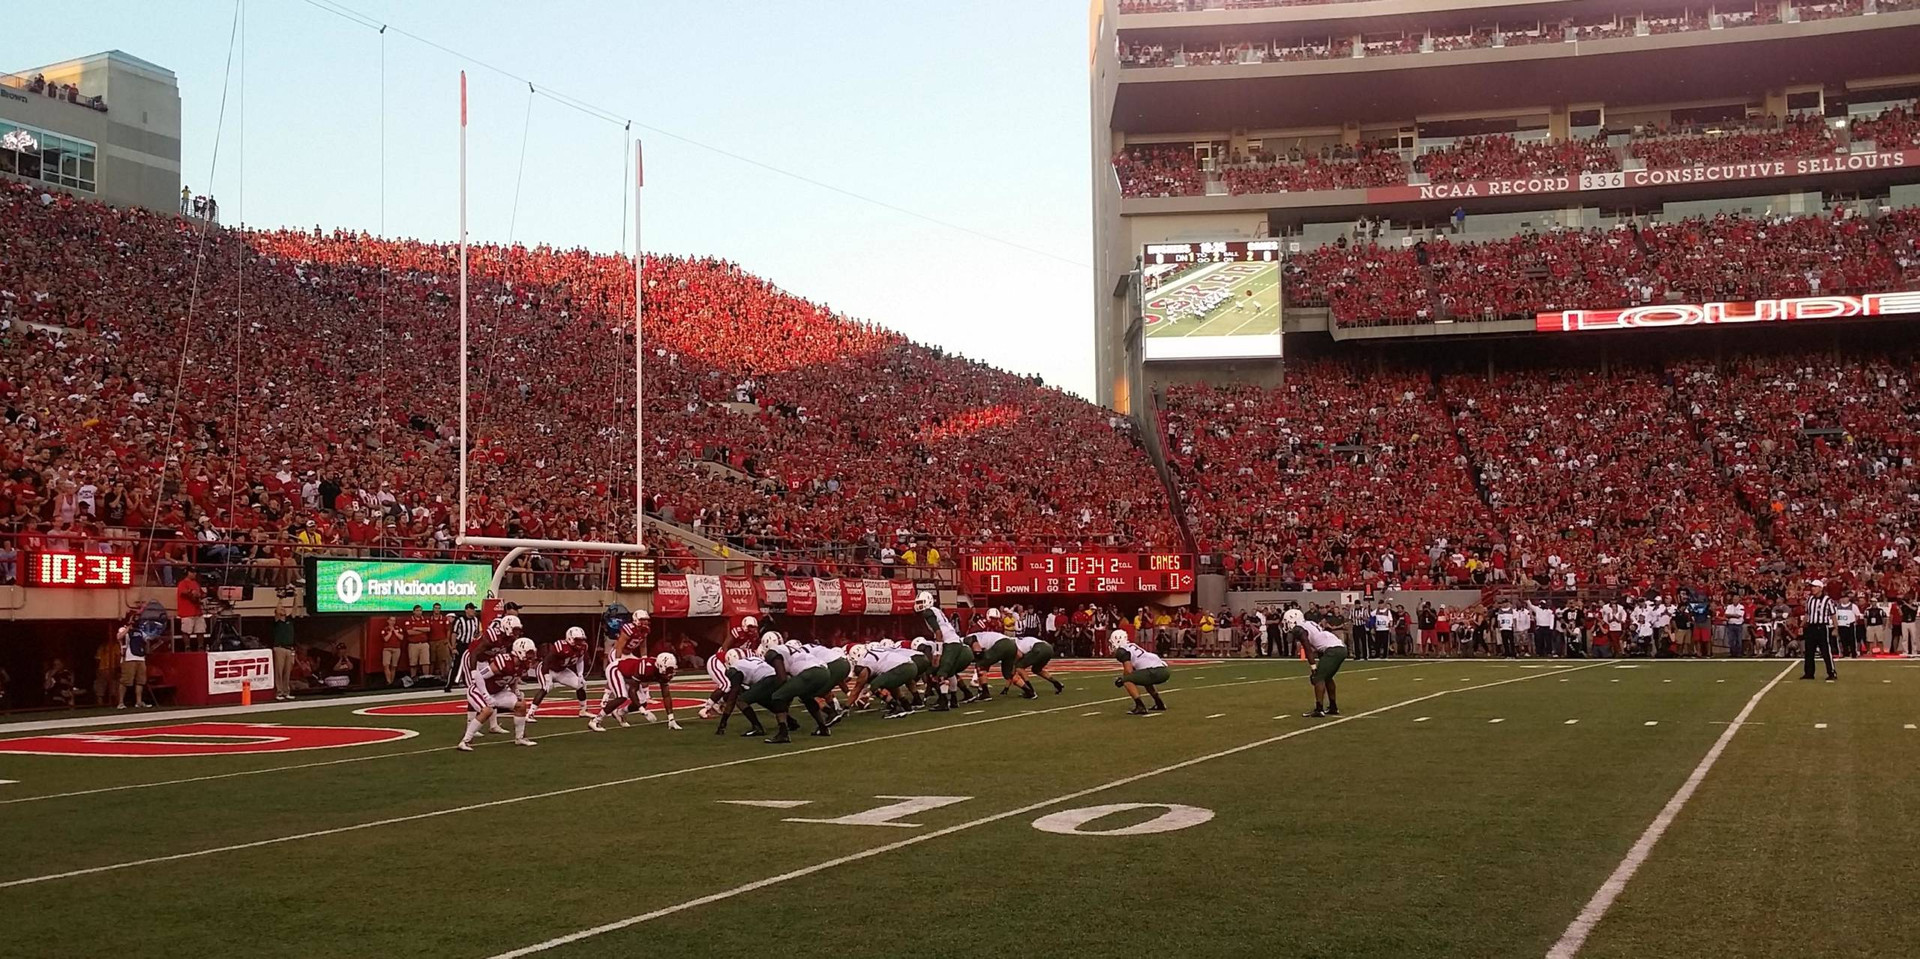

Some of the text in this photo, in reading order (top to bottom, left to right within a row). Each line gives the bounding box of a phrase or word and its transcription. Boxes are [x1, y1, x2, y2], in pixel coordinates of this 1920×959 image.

[1420, 152, 1905, 199] NCAA RECORD 336 CONSECUTIVE SELLOUTS
[41, 554, 131, 584] 10:34
[620, 559, 655, 587] 06
[972, 556, 1017, 571] HUSKERS
[1045, 559, 1054, 573] 3
[1066, 557, 1105, 574] 10:34
[1110, 558, 1119, 572] 2
[368, 580, 477, 595] First National Bank
[990, 575, 1001, 592] 0
[1005, 585, 1030, 593] DOWN
[1067, 577, 1076, 592] 2
[1097, 577, 1106, 591] 2
[1170, 573, 1180, 590] 0
[214, 657, 269, 679] ESPN
